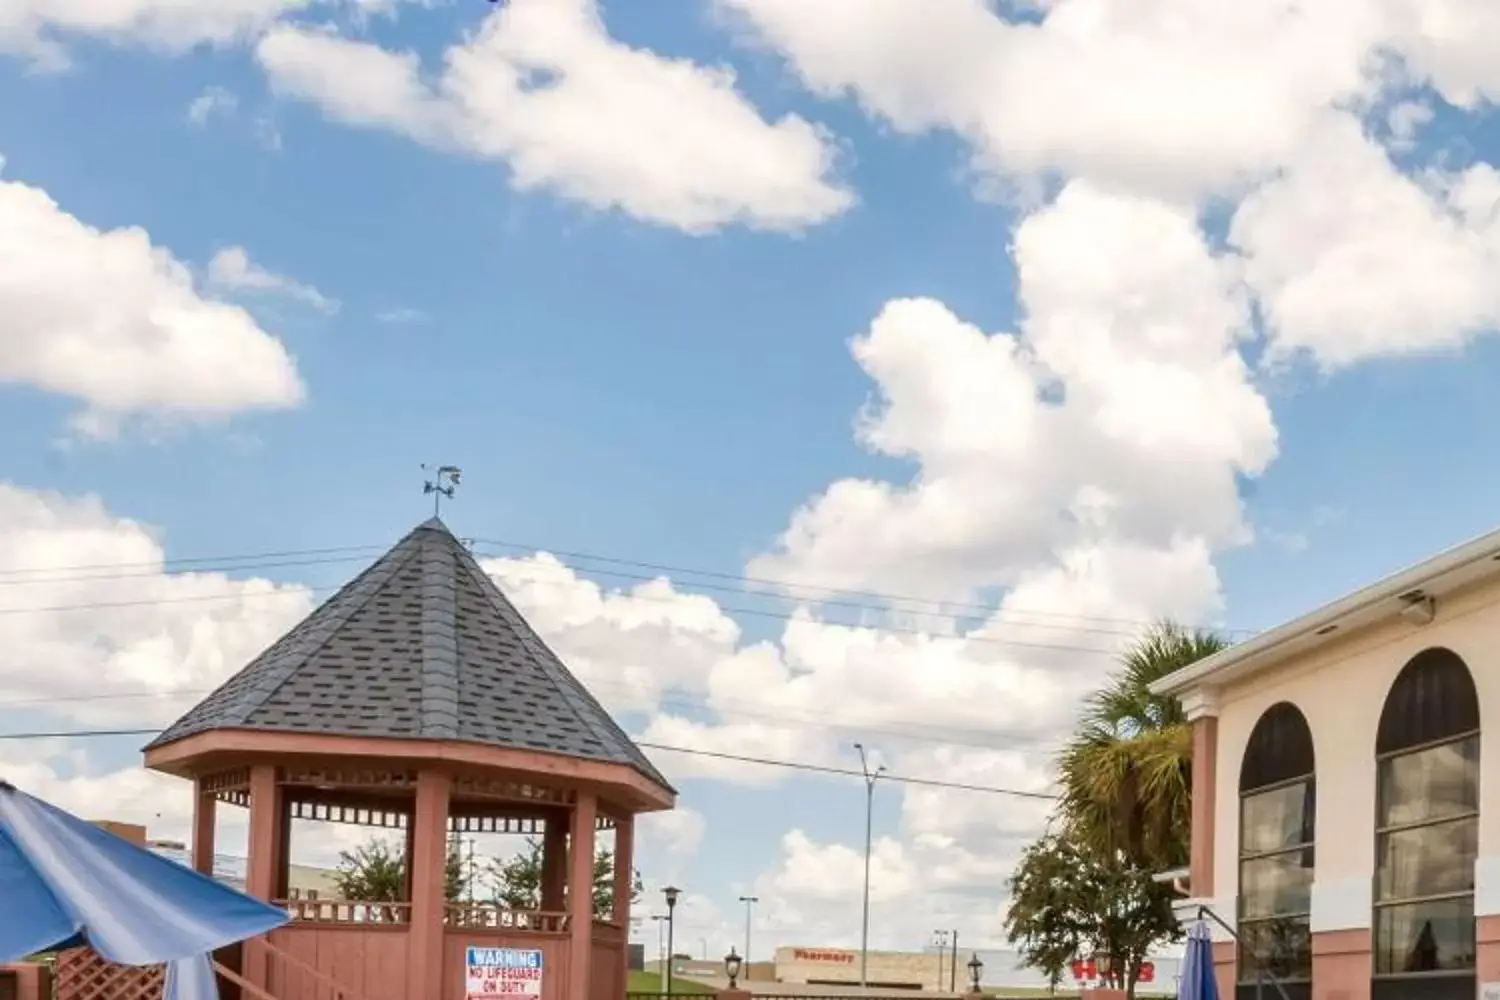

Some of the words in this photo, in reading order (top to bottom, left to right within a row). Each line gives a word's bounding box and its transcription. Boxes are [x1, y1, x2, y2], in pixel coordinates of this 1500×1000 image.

[475, 949, 538, 967] WARNING
[794, 949, 855, 964] Pharmacy
[469, 968, 483, 979] NO
[487, 968, 541, 981] LIFEGUARD
[483, 980, 497, 993] ON
[501, 981, 526, 993] DUTY
